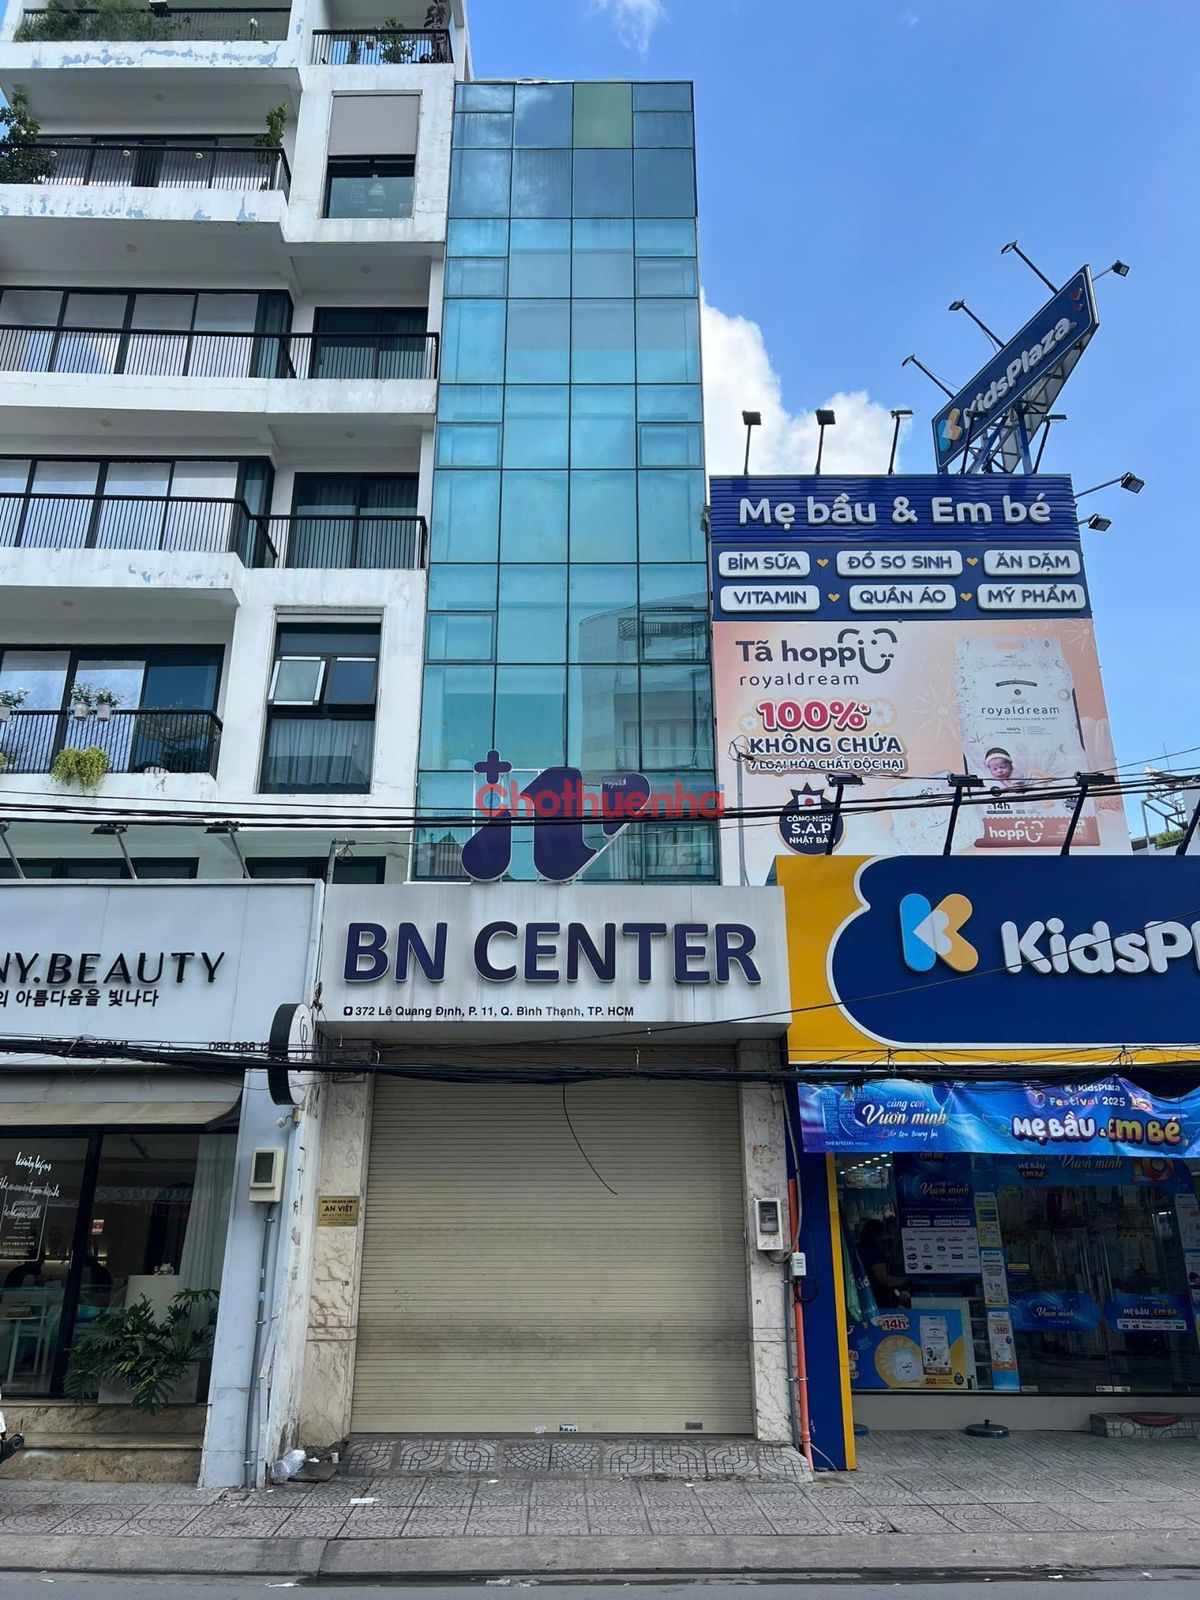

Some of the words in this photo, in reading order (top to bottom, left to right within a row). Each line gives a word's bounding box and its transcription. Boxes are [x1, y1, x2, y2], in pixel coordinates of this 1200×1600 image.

[963, 317, 1071, 430] KidsPlaza
[739, 498, 795, 531] Mẹ
[807, 492, 876, 524] bầu
[891, 496, 918, 524] &
[931, 496, 992, 524] Em
[1002, 492, 1051, 524] bé
[764, 553, 801, 570] SỮA
[881, 555, 906, 569] SƠ
[912, 555, 952, 569] SINH
[996, 552, 1022, 569] ĂN
[1029, 552, 1071, 572] DẶM
[733, 591, 807, 604] VITAMIN
[920, 586, 946, 603] ÁO
[988, 586, 1015, 603] MỸ
[1022, 584, 1077, 603] PHẨM
[735, 640, 773, 662] Tã
[781, 637, 891, 674] hoppi
[739, 672, 859, 689] royaldream
[981, 705, 1060, 717] royaldream
[750, 734, 831, 754] KHÔNG
[837, 732, 902, 754] CHỨA
[790, 759, 815, 769] HÓA
[820, 757, 850, 769] CHẤT
[854, 759, 882, 772] ĐỘC
[883, 760, 904, 772] HẠI
[812, 814, 833, 822] NGH
[791, 822, 831, 834] S.A.P
[989, 823, 1042, 842] hoppi
[789, 836, 814, 845] NHẬT
[816, 835, 835, 844] BẢ
[343, 921, 449, 984] BN
[473, 920, 763, 985] CENTER
[16, 989, 101, 1008] 아름다움을
[108, 989, 159, 1008] 빛나다
[355, 1006, 375, 1017] 372
[378, 1005, 392, 1016] Lê
[395, 1006, 432, 1020] Quang
[468, 1006, 479, 1016] P.
[482, 1006, 498, 1018] 11,
[501, 1006, 513, 1017] Q.
[517, 1005, 542, 1016] Bình
[546, 1006, 585, 1019] Thạnh,
[588, 1006, 605, 1016] TP.
[608, 1006, 634, 1016] HCM
[1078, 1083, 1120, 1093] KidsPlaza
[1049, 1097, 1099, 1106] Festival
[1102, 1096, 1126, 1107] 2025
